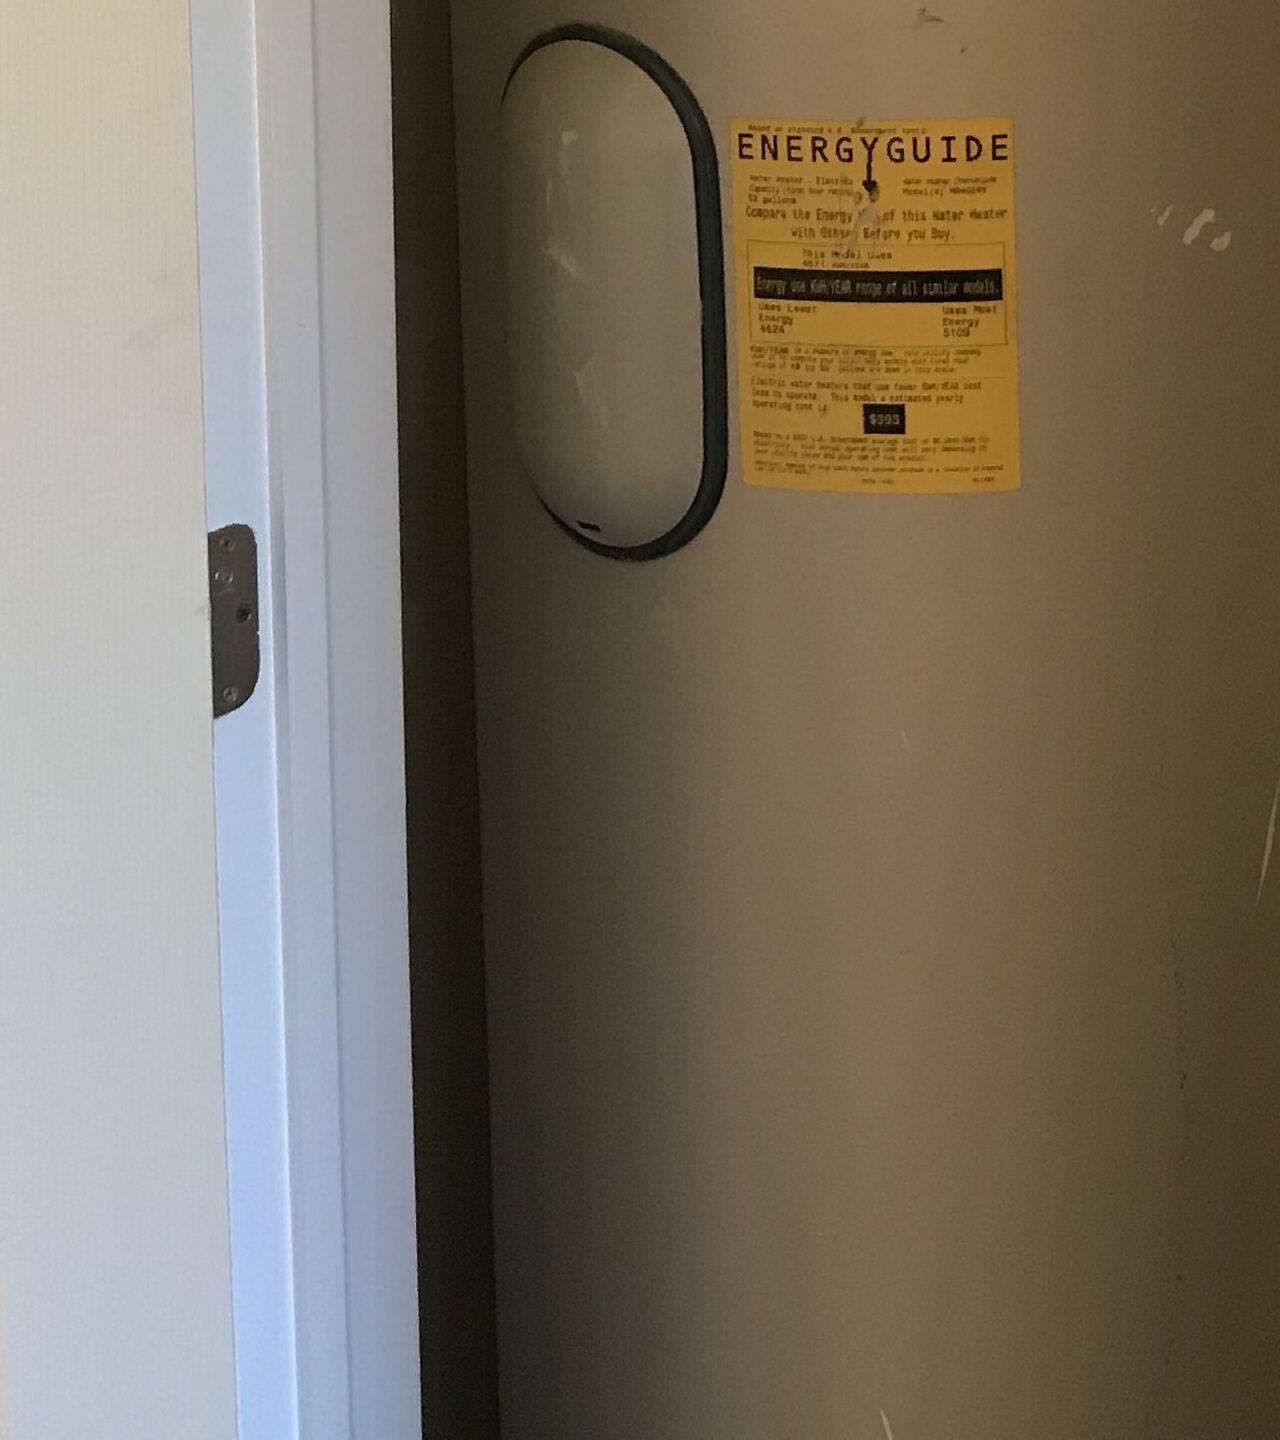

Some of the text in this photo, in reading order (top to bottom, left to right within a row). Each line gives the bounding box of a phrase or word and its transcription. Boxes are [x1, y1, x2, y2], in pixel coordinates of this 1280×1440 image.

[738, 133, 1008, 163] ENERGYGUIDE
[745, 205, 787, 221] Compare
[793, 208, 811, 220] the
[816, 208, 853, 224] Energy
[882, 208, 896, 222] of
[902, 210, 927, 222] this
[933, 210, 964, 220] Water
[969, 208, 1008, 220] Heater
[791, 227, 816, 238] with
[863, 228, 901, 239] Before
[907, 229, 926, 242] you
[931, 227, 955, 241] Buy.
[756, 275, 787, 296] Energy
[789, 279, 807, 293] use
[901, 279, 919, 296] all
[922, 279, 960, 296] similar
[758, 313, 794, 326] Energy
[942, 317, 980, 328] Energy
